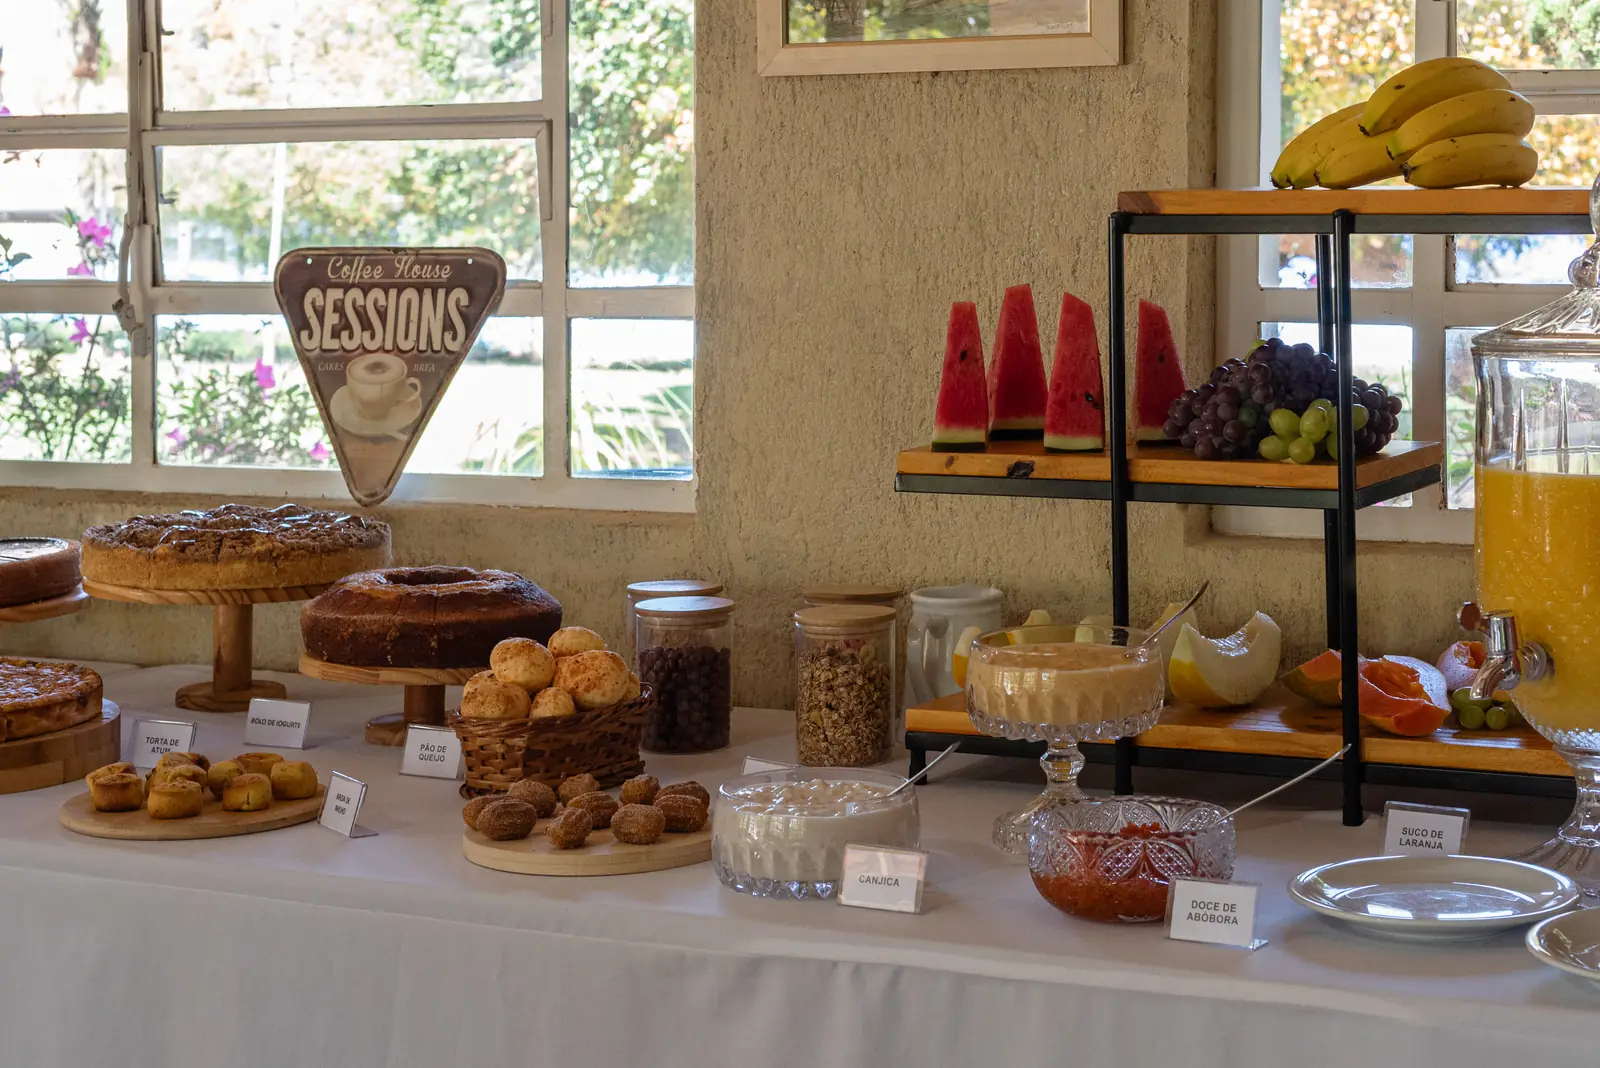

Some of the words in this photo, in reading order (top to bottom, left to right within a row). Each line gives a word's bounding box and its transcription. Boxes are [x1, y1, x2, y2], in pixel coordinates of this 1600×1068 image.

[327, 256, 384, 283] Coffee
[395, 255, 452, 278] House
[300, 287, 469, 351] SESSIONS
[318, 362, 345, 371] CAKES
[251, 717, 267, 726] BOLO
[267, 719, 276, 727] DE
[276, 719, 302, 729] IOGURTE
[146, 736, 168, 746] TORTA
[169, 738, 180, 747] DE
[420, 743, 435, 752] PÃO
[436, 745, 447, 753] DE
[419, 753, 445, 762] QUEIJO
[1401, 827, 1428, 837] SUCO
[1430, 829, 1444, 839] DE
[1399, 838, 1443, 850] LARANJA
[858, 874, 900, 887] CANJICA
[1191, 900, 1220, 911] DOCE
[1222, 903, 1237, 913] DE
[1186, 911, 1239, 926] ABÓBORA
